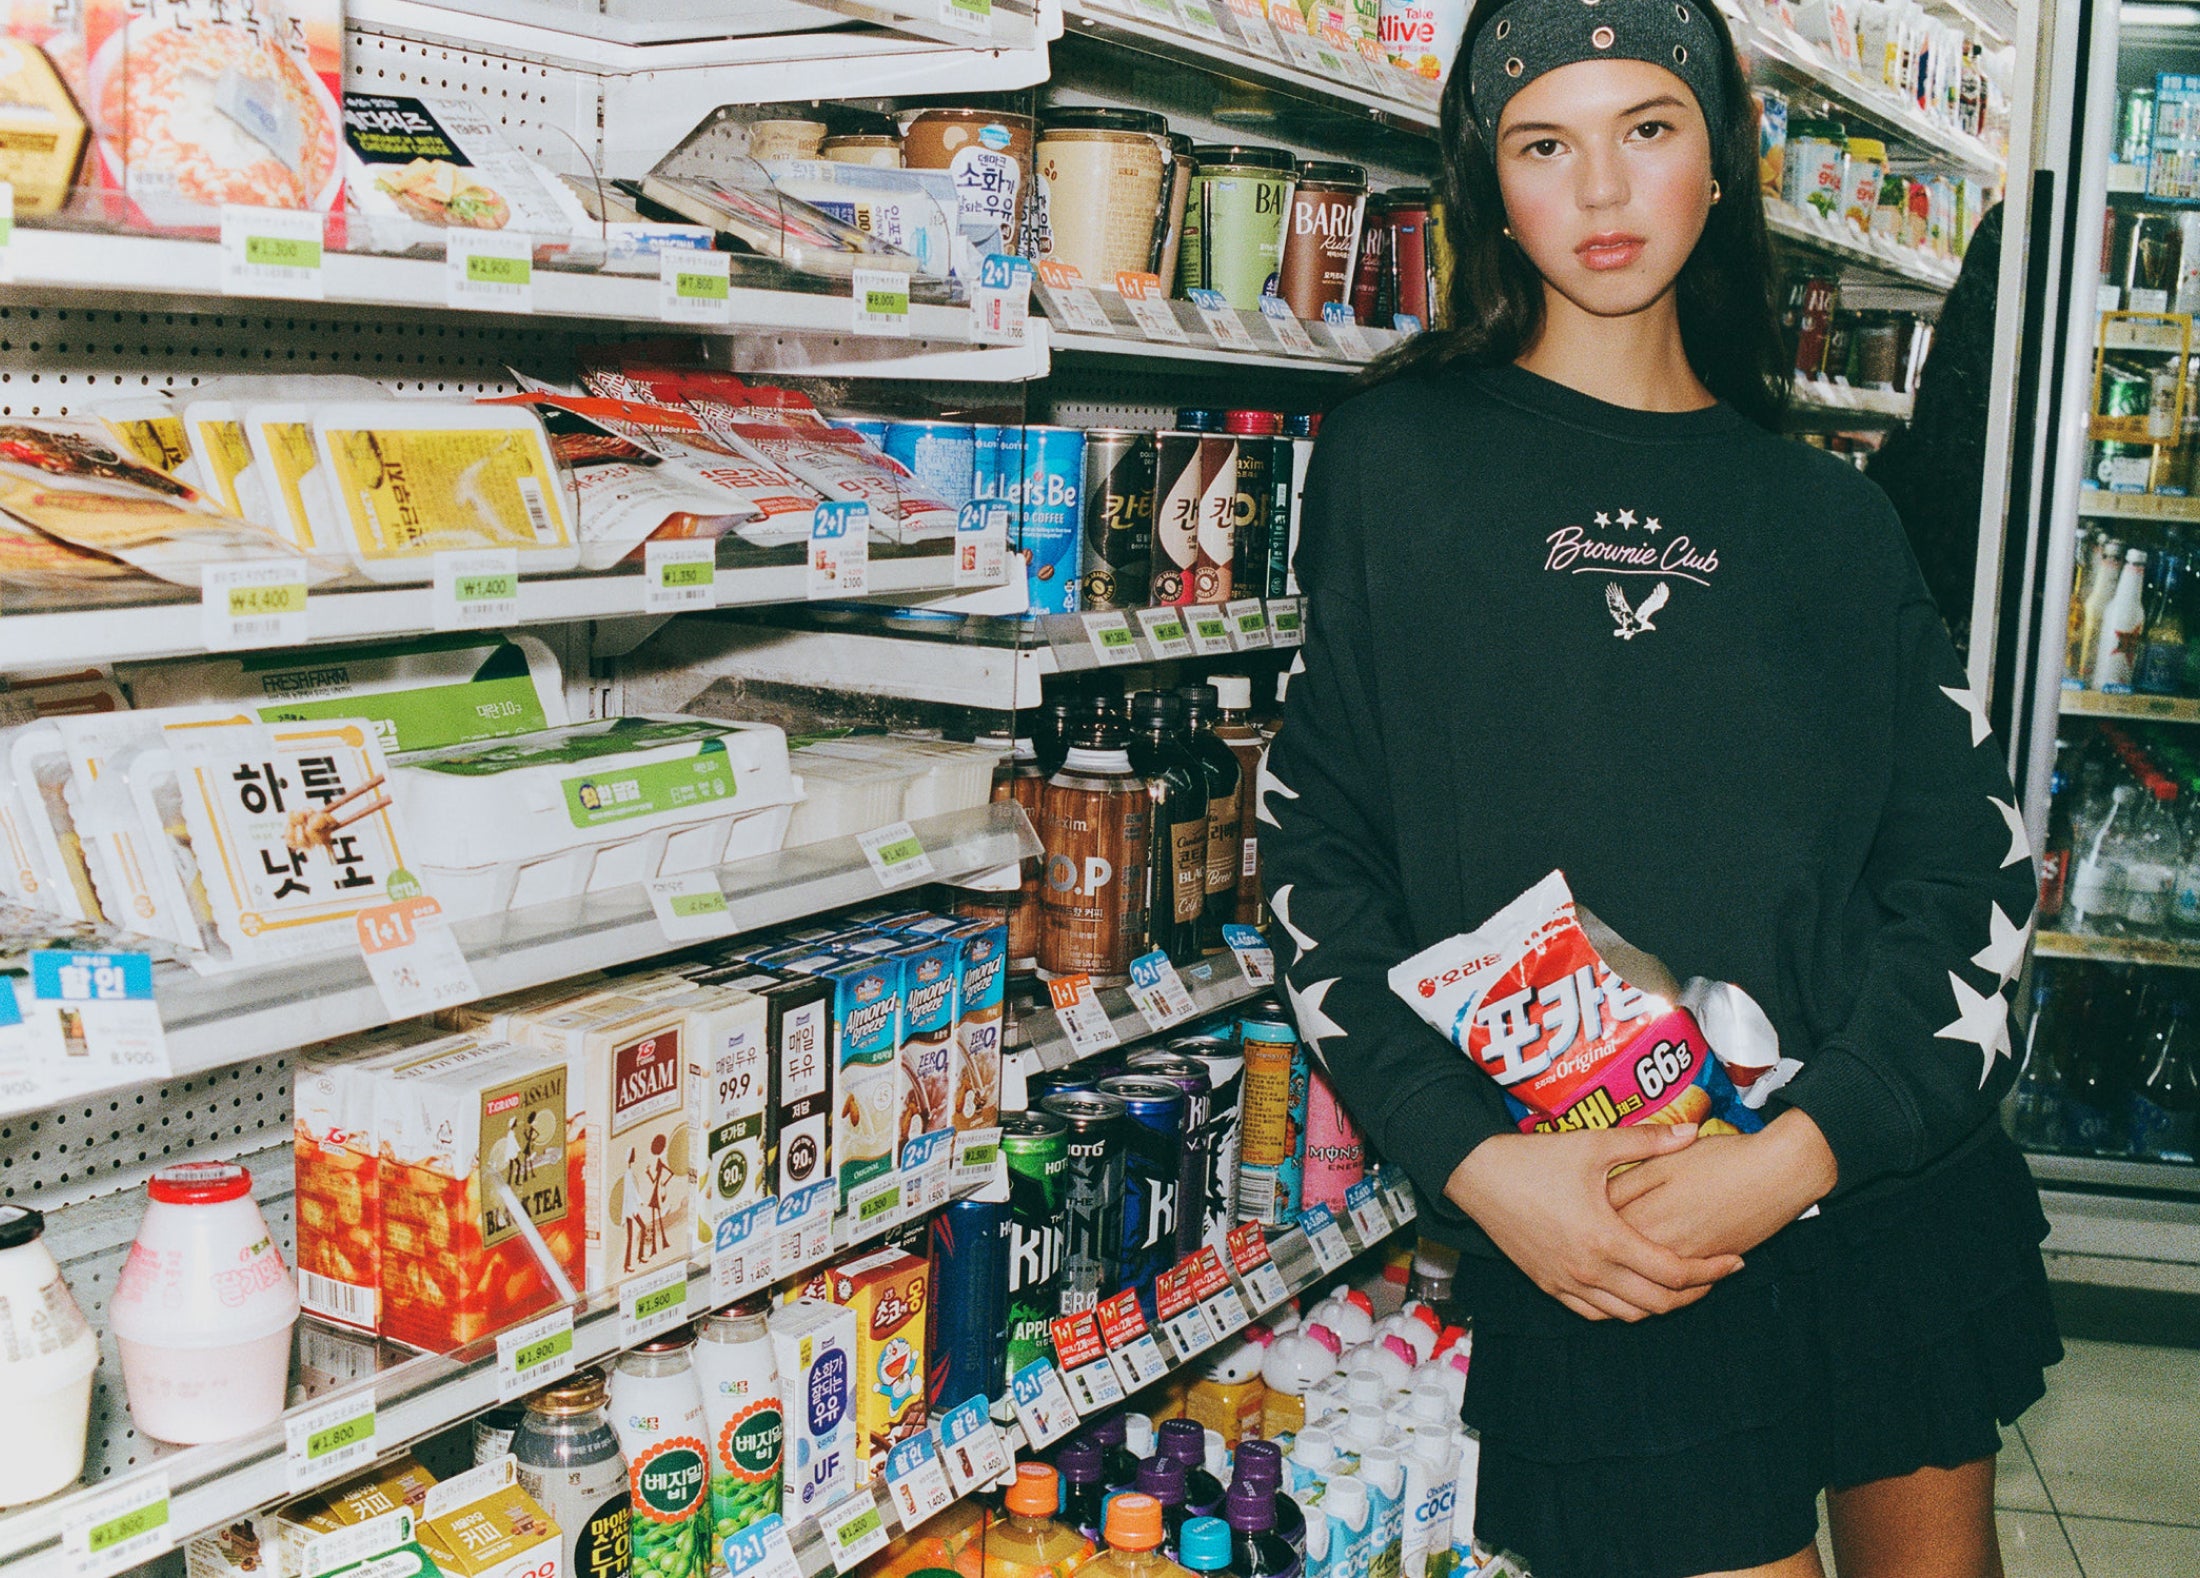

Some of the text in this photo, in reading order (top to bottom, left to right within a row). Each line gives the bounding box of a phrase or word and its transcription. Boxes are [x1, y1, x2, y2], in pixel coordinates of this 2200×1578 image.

[1405, 8, 1433, 20] Take
[978, 153, 1008, 169] 덴마크
[983, 195, 1014, 222] 우유
[1295, 201, 1361, 238] BARIS
[984, 263, 1010, 287] 2+1
[1043, 267, 1067, 290] 1+1
[1120, 278, 1145, 299] 1+1
[1326, 306, 1343, 323] 2+1
[1047, 473, 1077, 508] Be
[816, 508, 844, 537] 2+1
[960, 503, 987, 532] 2+1
[1031, 511, 1065, 525] COFFEE
[1544, 525, 1720, 573] Brownie Club
[232, 756, 348, 814] 하루
[363, 912, 408, 948] 1+1
[962, 953, 1001, 994] Almond
[1133, 961, 1156, 987] 2+1
[1440, 952, 1503, 987] 오리온
[905, 972, 953, 1016] Almond
[965, 976, 992, 1004] Breeze
[1052, 983, 1074, 1006] 1+1
[843, 990, 897, 1038] Almond
[911, 996, 943, 1025] Breeze
[788, 1025, 815, 1053] 매일
[851, 1014, 886, 1048] Breeze
[715, 1046, 758, 1076] 매일두유
[788, 1056, 816, 1084] 두유
[1556, 1042, 1617, 1080] Original
[1635, 1041, 1693, 1099] 66g
[521, 1077, 561, 1108] ASSAM
[618, 1059, 675, 1109] ASSAM
[719, 1072, 751, 1105] 99.9
[720, 1122, 747, 1145] 무가당
[904, 1139, 932, 1169] 2+1
[1328, 1162, 1361, 1172] ENER
[485, 1185, 563, 1237] BLK TEA
[783, 1190, 812, 1220] 2+1
[720, 1212, 751, 1247] 2+1
[1100, 1301, 1120, 1326] 1+1
[1053, 1321, 1074, 1345] 1+1
[517, 1341, 556, 1367] ₩1,900
[811, 1354, 843, 1386] 소화가
[811, 1376, 843, 1406] 잘되는
[1014, 1372, 1041, 1403] 2+1
[813, 1395, 841, 1428] 우유
[950, 1409, 981, 1441] 할인
[311, 1424, 355, 1452] ₩1,800
[813, 1451, 840, 1485] UF
[894, 1442, 926, 1475] 할인
[644, 1461, 703, 1492] 베지밀
[349, 1491, 395, 1522] 커피
[666, 1482, 687, 1502] 비
[458, 1520, 503, 1550] 커피
[728, 1533, 764, 1576] 2+1
